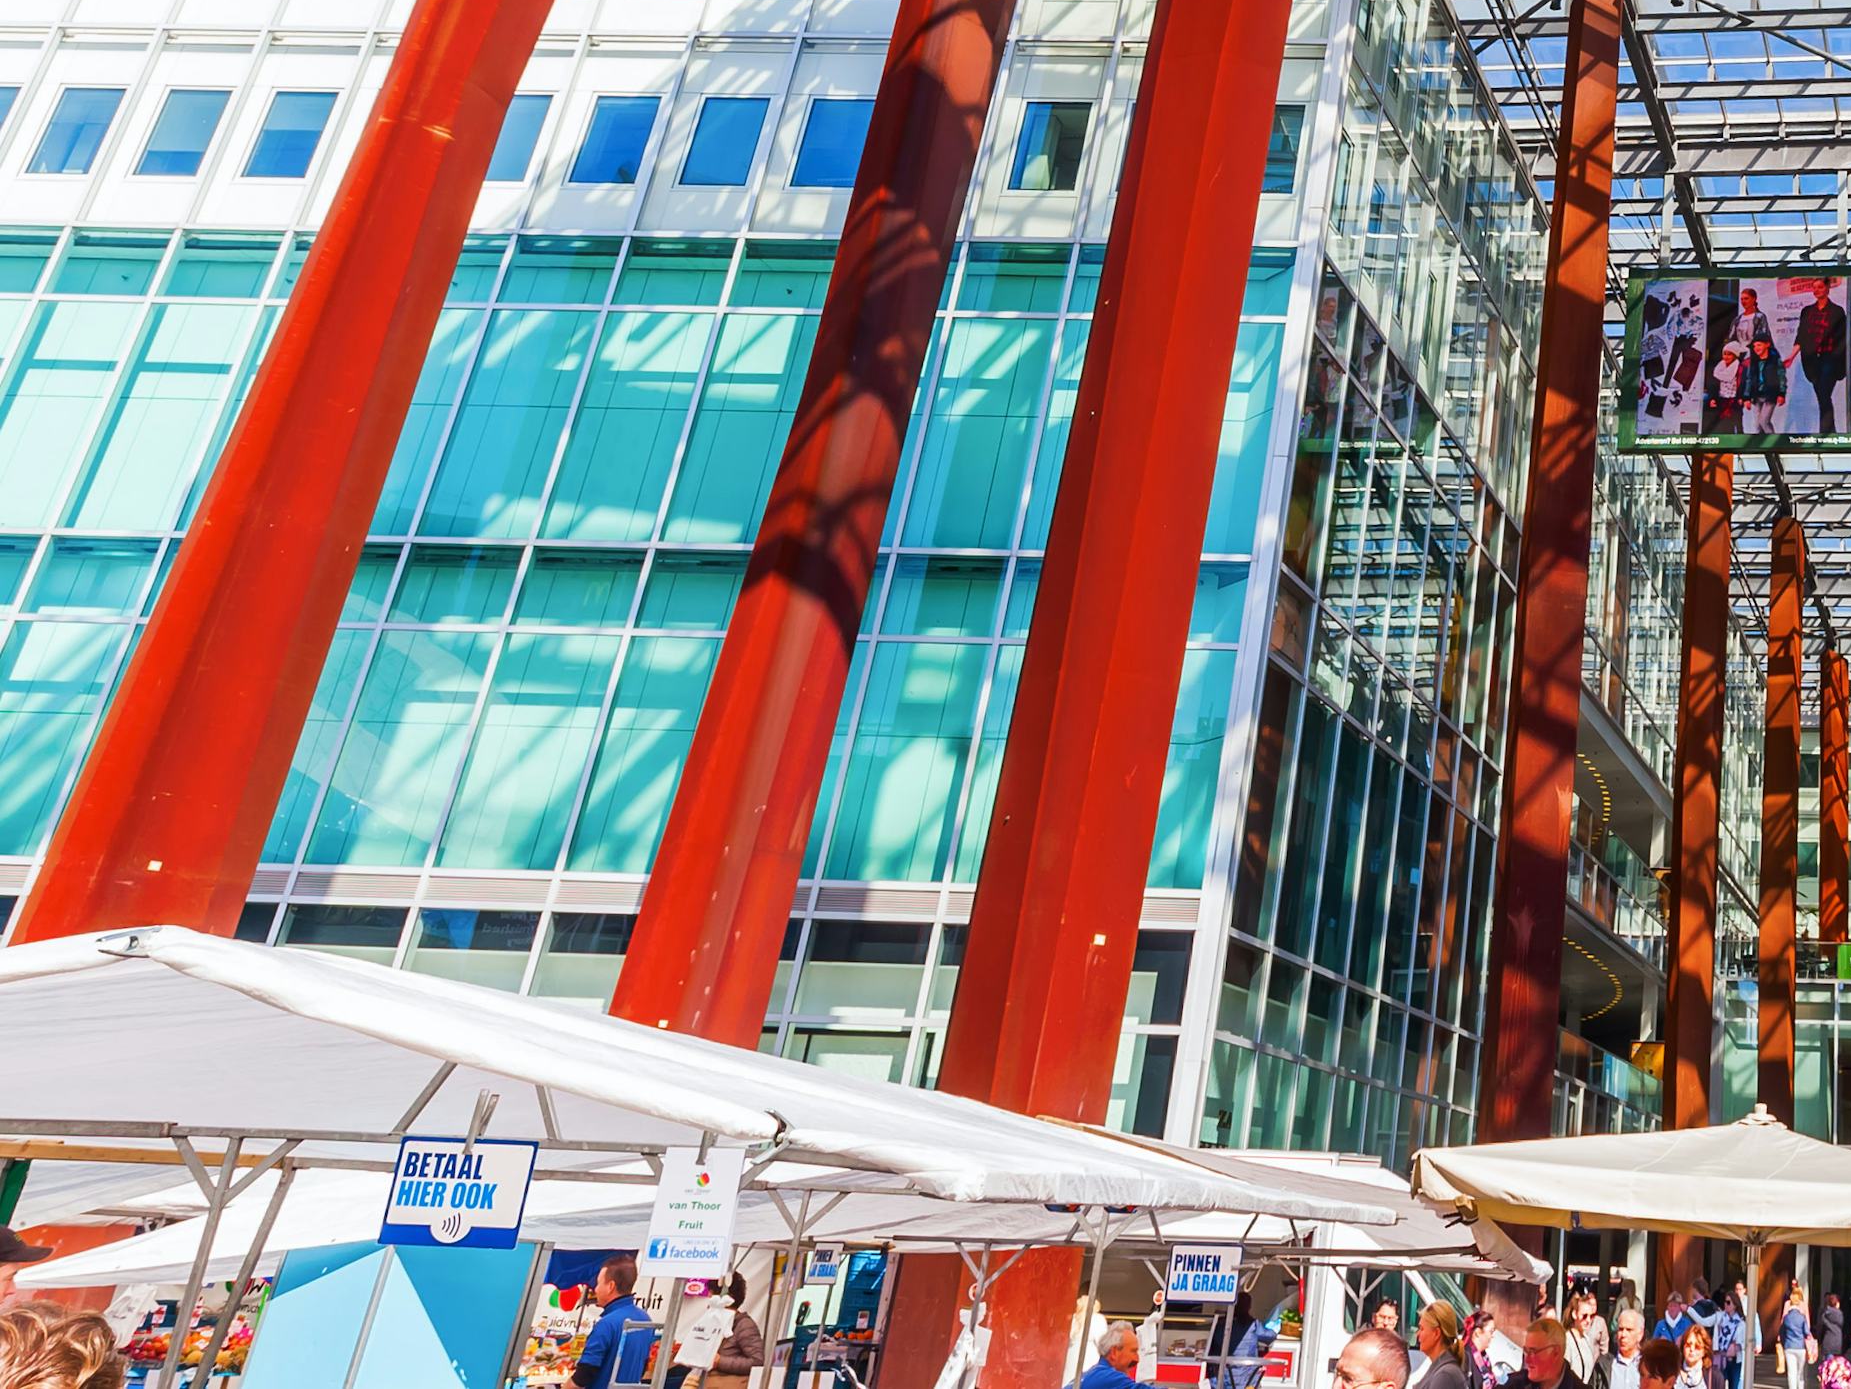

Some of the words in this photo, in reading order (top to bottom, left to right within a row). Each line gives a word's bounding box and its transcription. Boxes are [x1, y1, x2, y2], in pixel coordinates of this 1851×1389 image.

[403, 1152, 483, 1180] BETAAL
[396, 1180, 447, 1207] HIER
[450, 1182, 498, 1210] OOK
[669, 1202, 687, 1210] van
[678, 1220, 704, 1229] Fruit
[669, 1246, 720, 1259] facebook
[1174, 1254, 1221, 1272] PINNEN
[1171, 1273, 1188, 1291] JA
[1192, 1274, 1235, 1293] GRAAG
